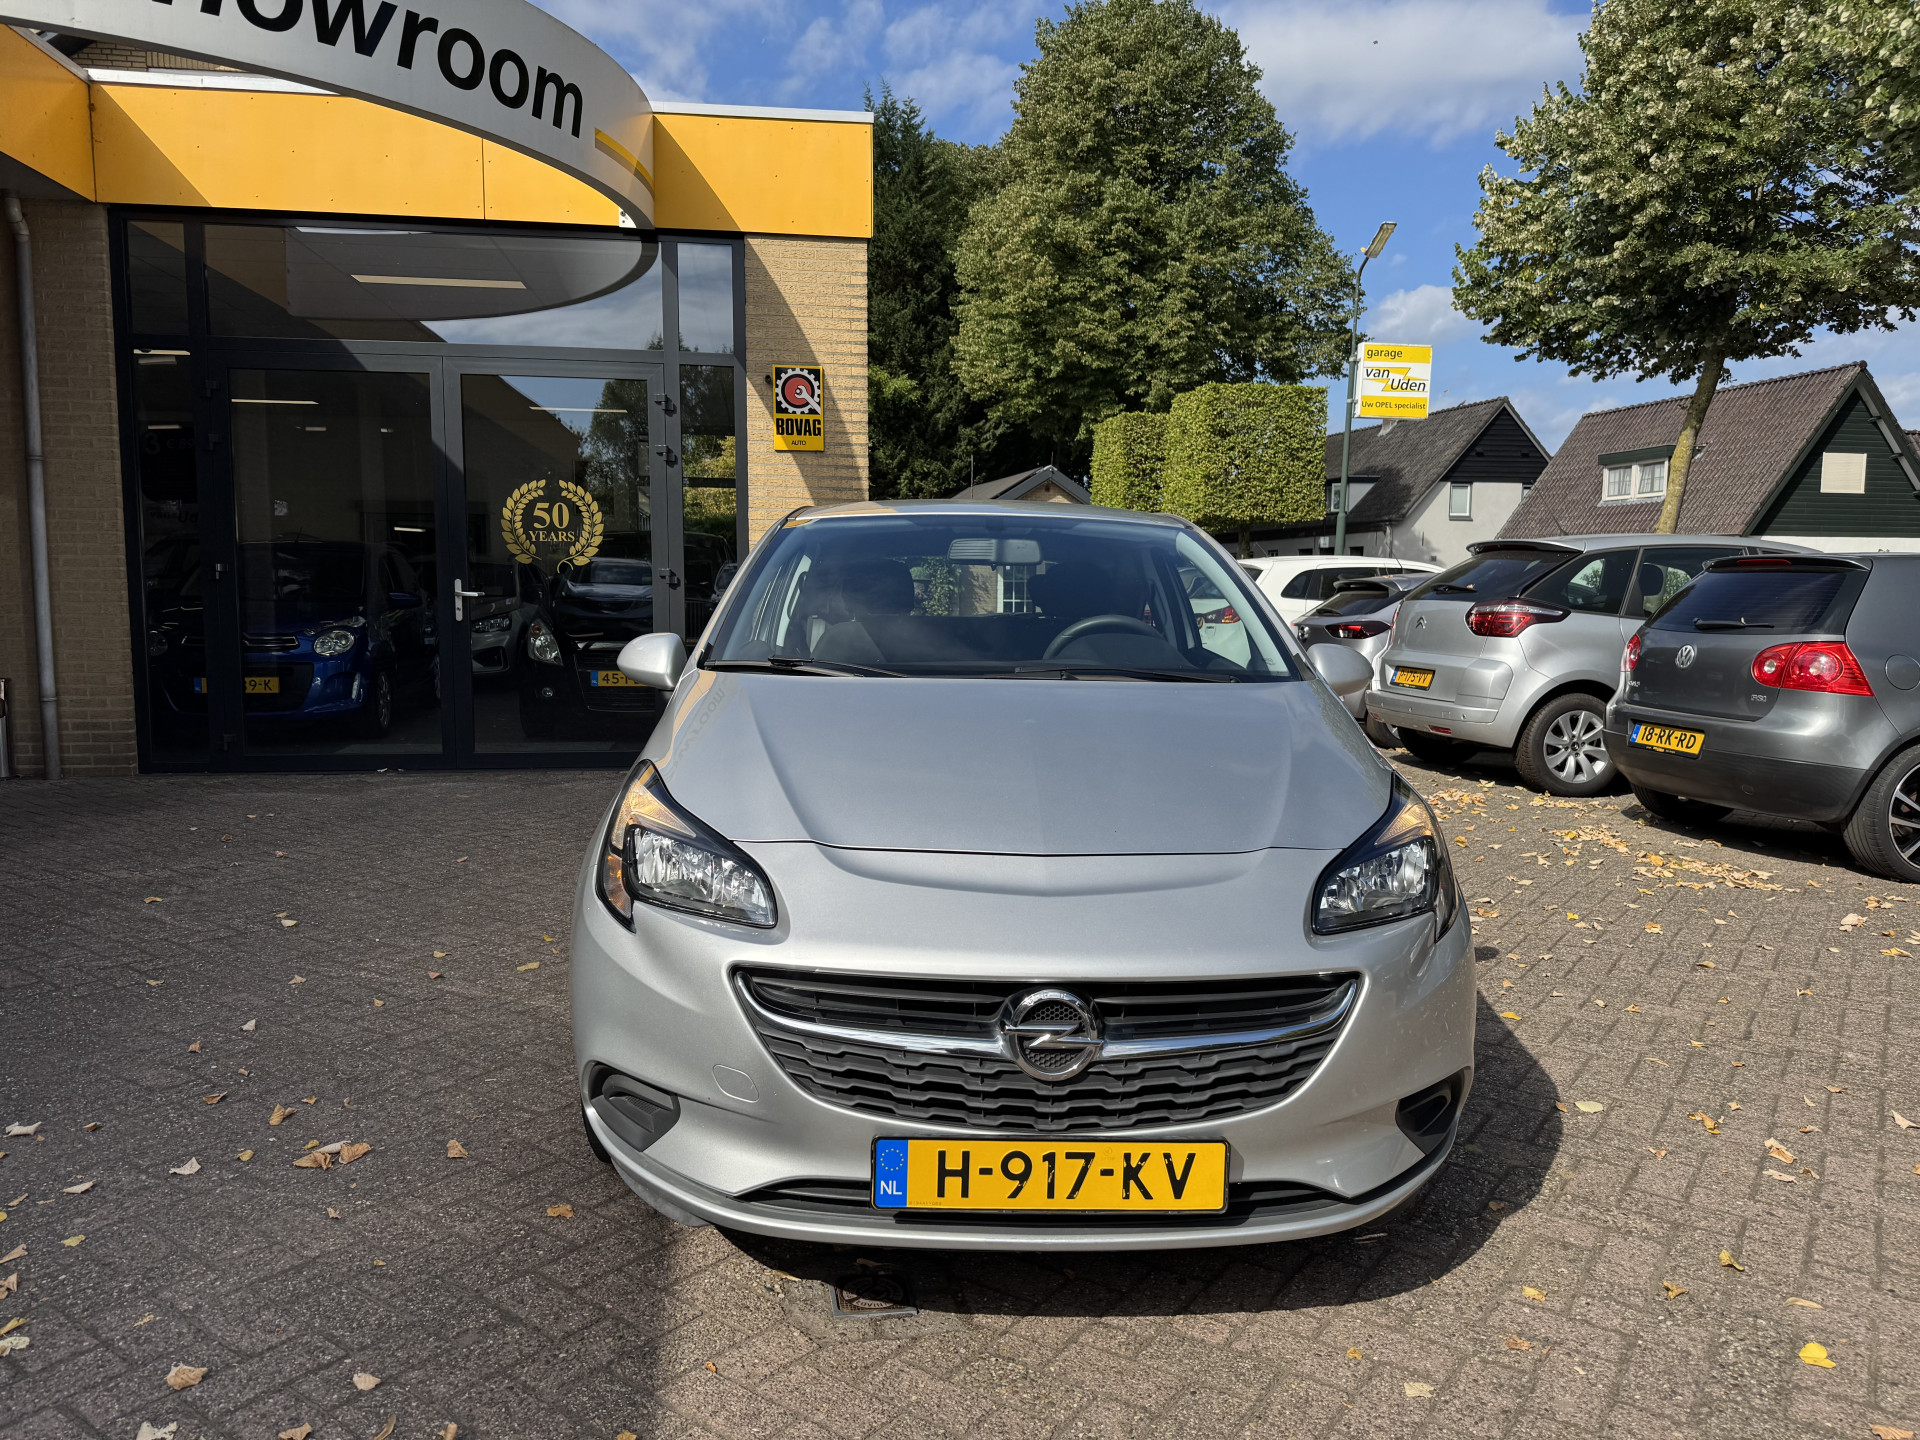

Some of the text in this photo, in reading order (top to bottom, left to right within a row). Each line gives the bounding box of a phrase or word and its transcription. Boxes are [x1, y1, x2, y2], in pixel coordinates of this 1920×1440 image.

[152, 0, 584, 138] owroom
[1366, 349, 1403, 360] garage
[1365, 368, 1390, 378] van
[1390, 379, 1426, 392] Uden
[1394, 402, 1426, 411] specialist
[775, 418, 822, 436] BOVAG
[533, 502, 570, 529] 50
[529, 531, 575, 542] YEARS
[1641, 727, 1697, 749] 18-RK-RD
[880, 1150, 1197, 1200] NL H-917-KV
